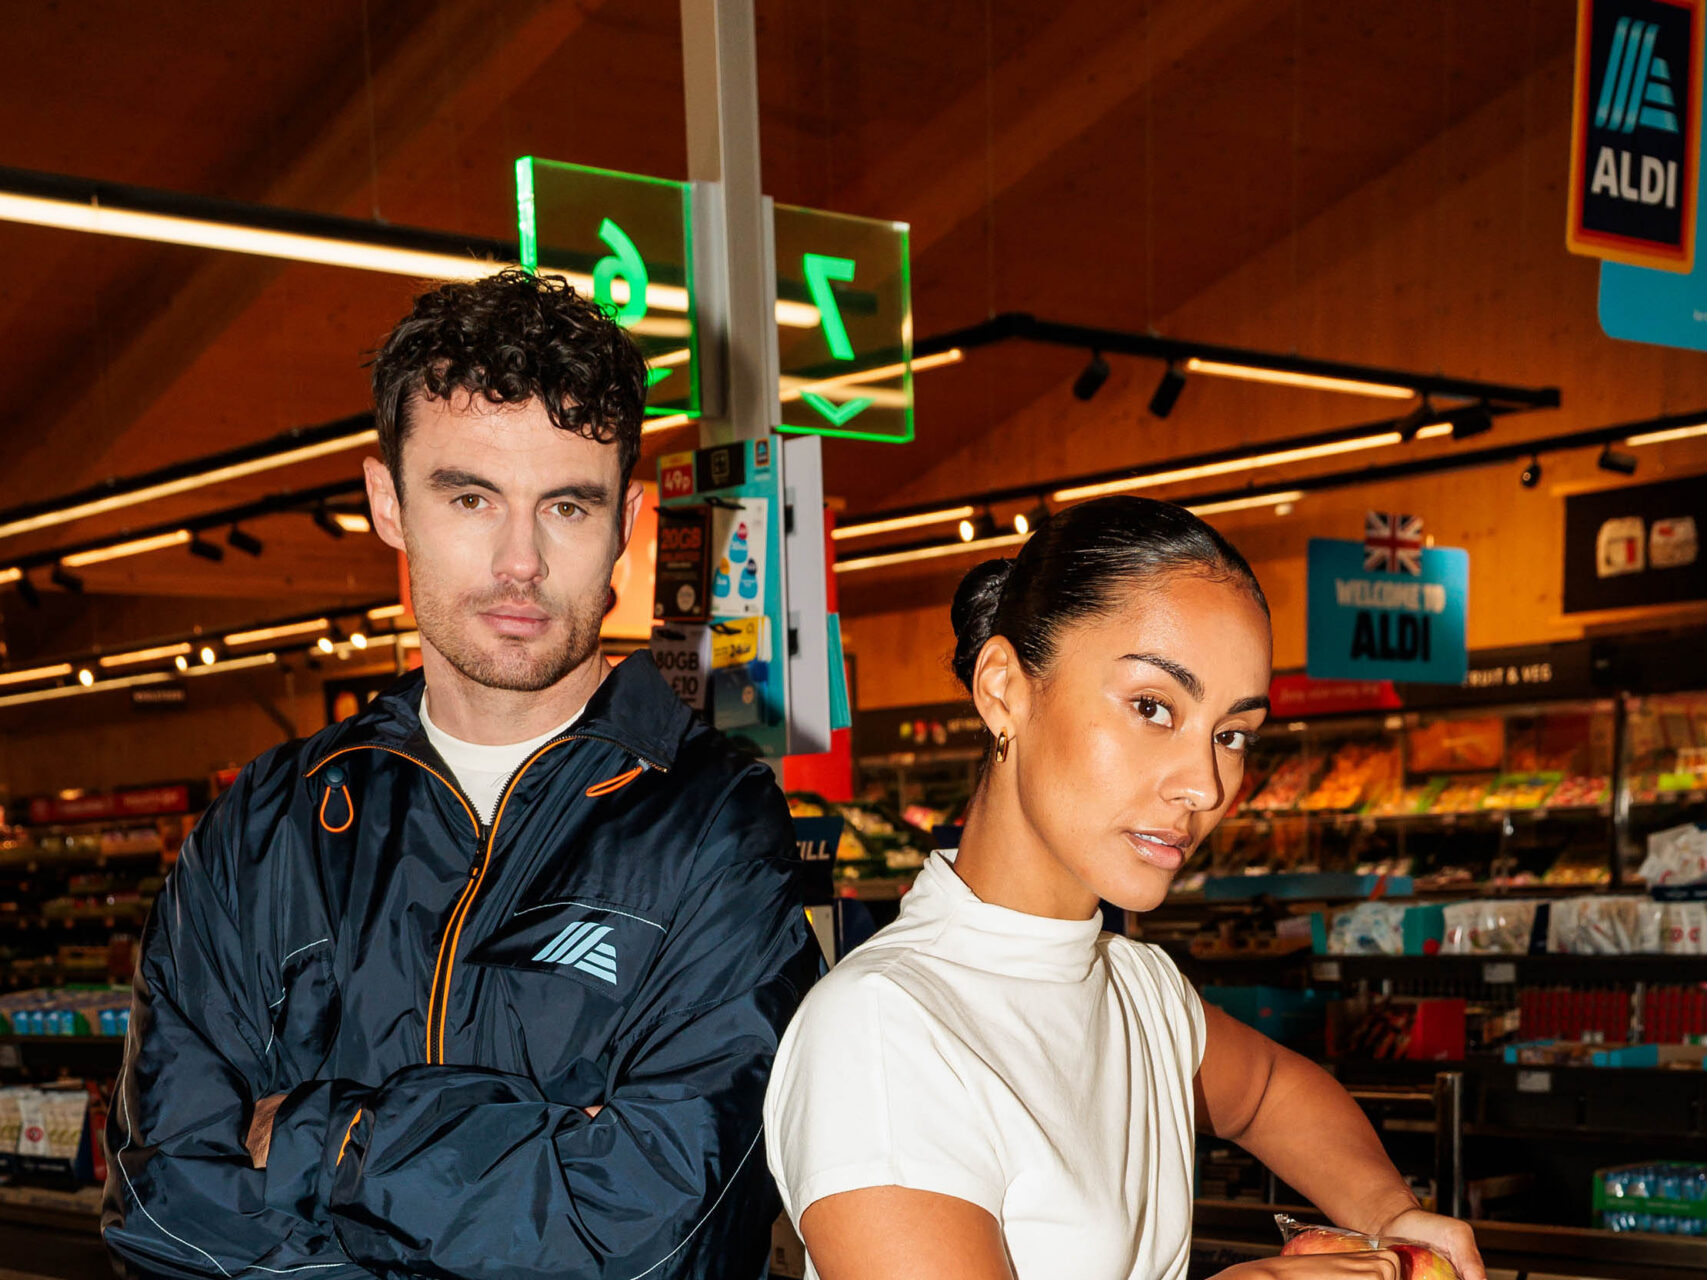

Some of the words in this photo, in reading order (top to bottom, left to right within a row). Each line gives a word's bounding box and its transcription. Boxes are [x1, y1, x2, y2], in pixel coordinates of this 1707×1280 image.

[1590, 146, 1678, 209] ALDI
[1335, 578, 1420, 611] WELCOME
[1350, 611, 1432, 661] ALDI
[1521, 663, 1552, 683] VEG
[795, 839, 831, 861] ILL
